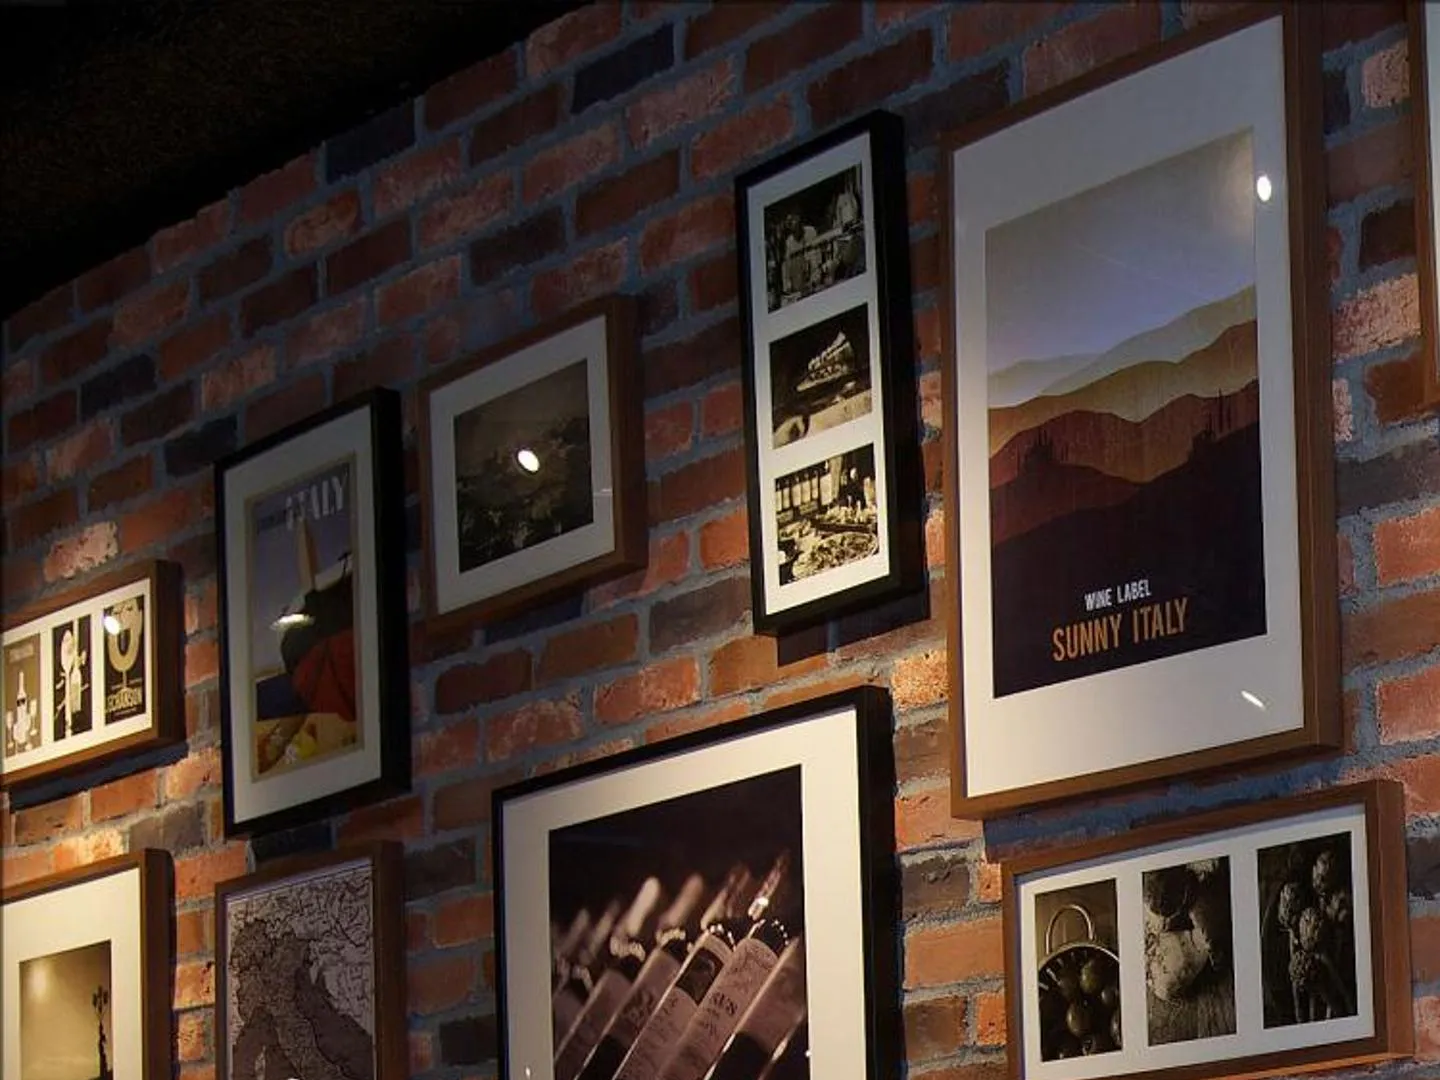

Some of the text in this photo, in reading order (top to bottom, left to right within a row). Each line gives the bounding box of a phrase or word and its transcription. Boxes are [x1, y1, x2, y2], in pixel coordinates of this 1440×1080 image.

[1085, 580, 1151, 611] WINE LABEL
[1053, 598, 1188, 661] SUNNY ITALY
